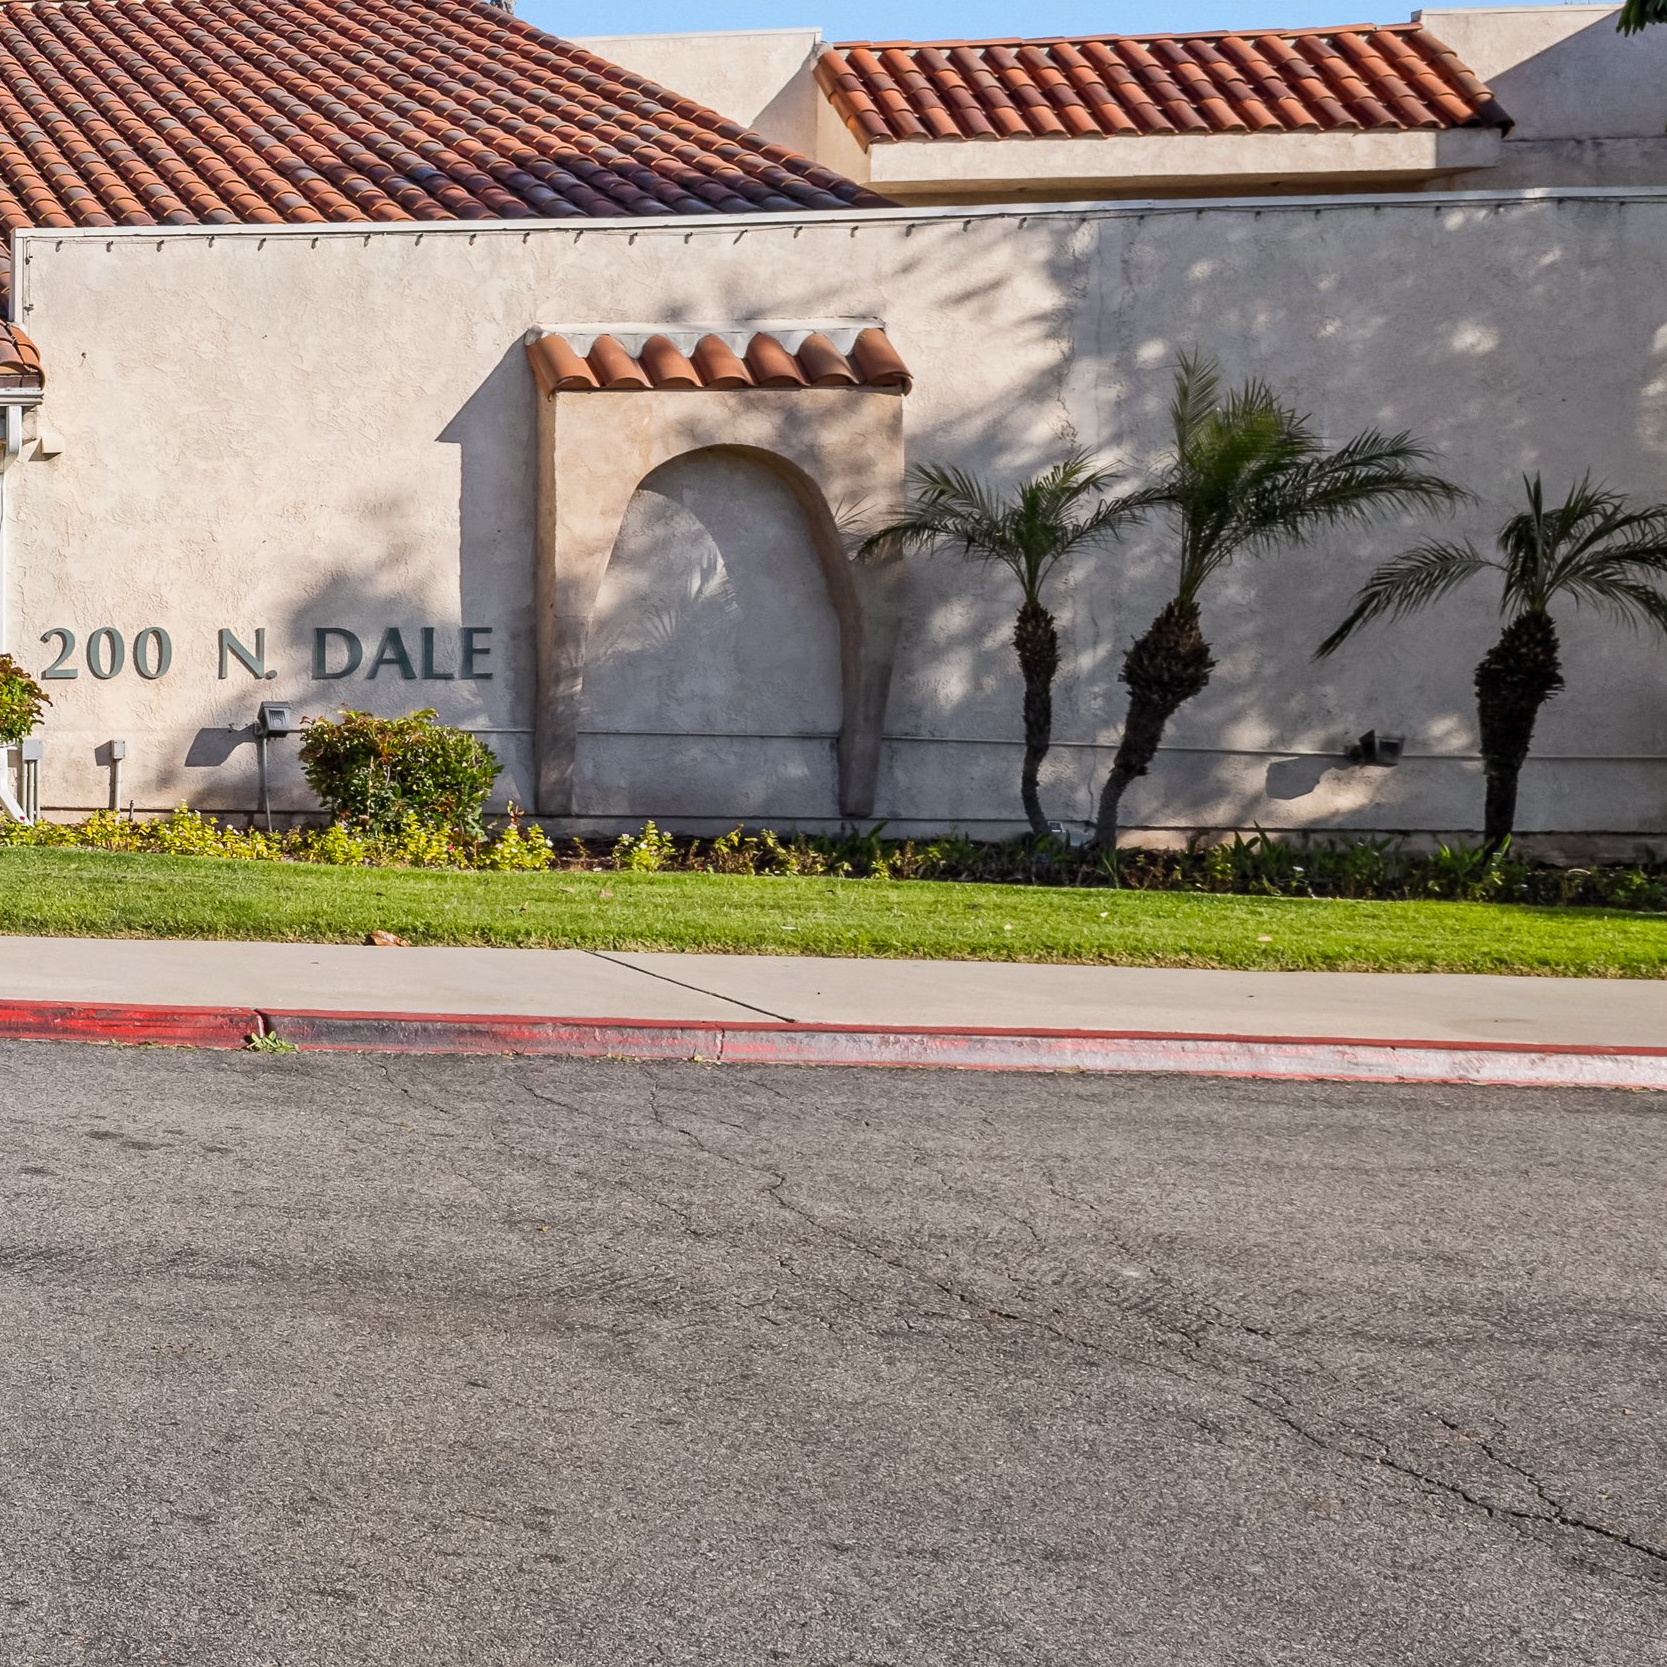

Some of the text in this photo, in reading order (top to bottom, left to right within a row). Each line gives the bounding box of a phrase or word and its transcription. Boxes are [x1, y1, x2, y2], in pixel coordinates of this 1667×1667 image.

[40, 627, 493, 680] 200 N. DALE
